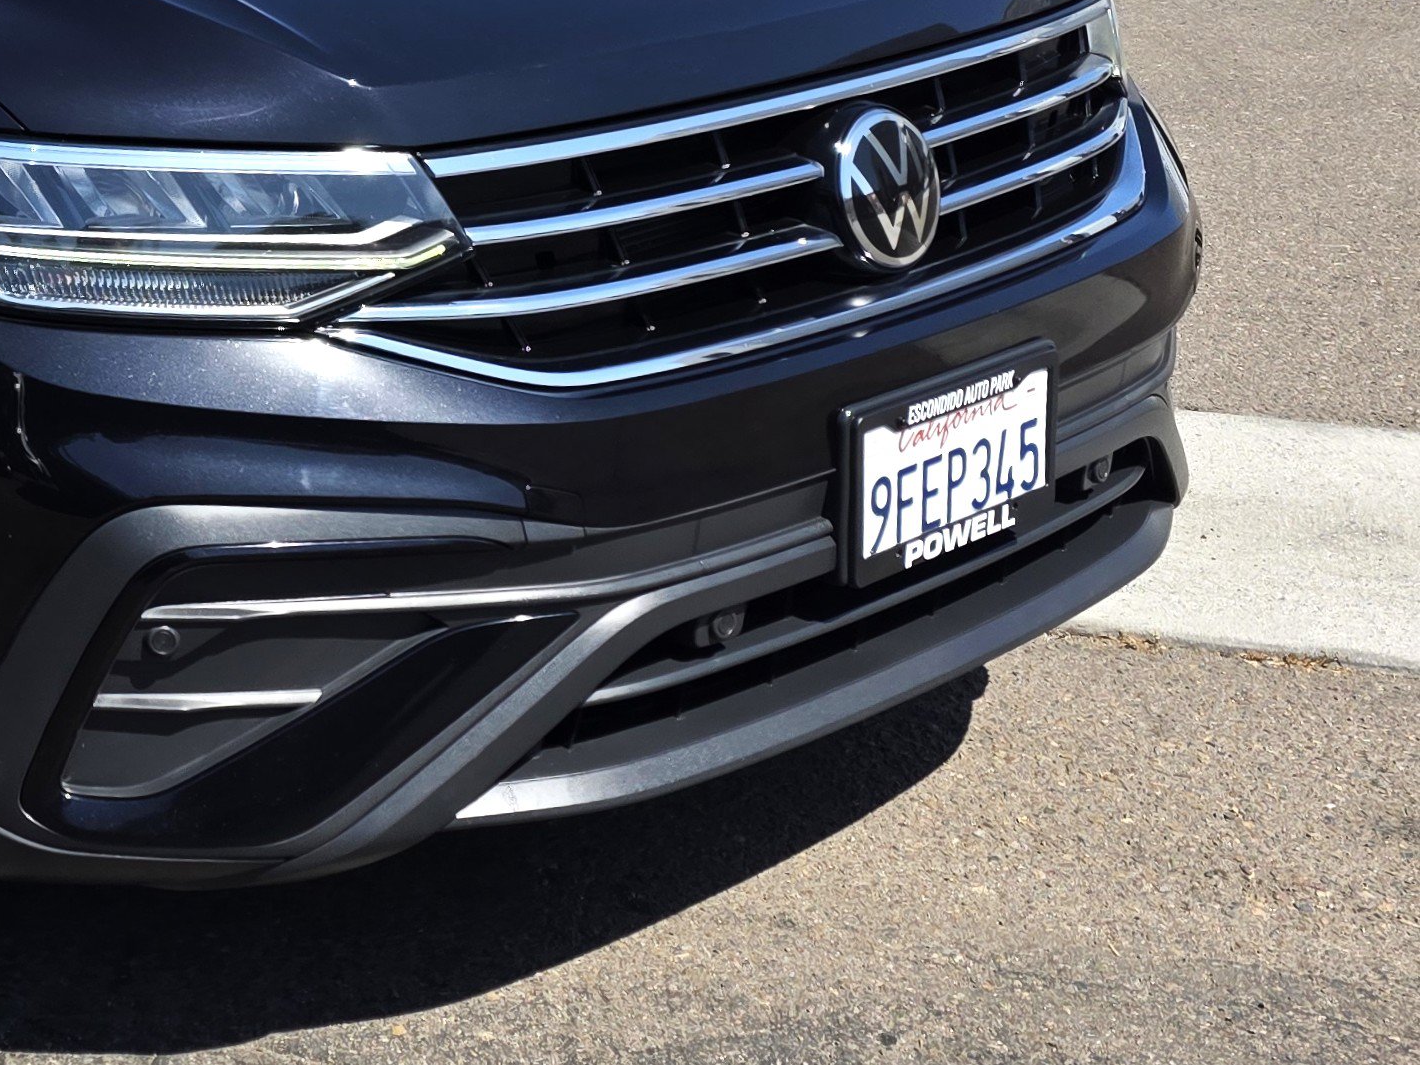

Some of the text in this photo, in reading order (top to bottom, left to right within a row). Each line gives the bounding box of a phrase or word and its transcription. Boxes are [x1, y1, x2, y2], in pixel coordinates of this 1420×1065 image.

[898, 393, 1018, 453] California
[907, 369, 1015, 425] ESCONDIDO AUTO PARK
[871, 417, 1039, 554] 9FEP345
[904, 503, 1016, 569] POWELL
